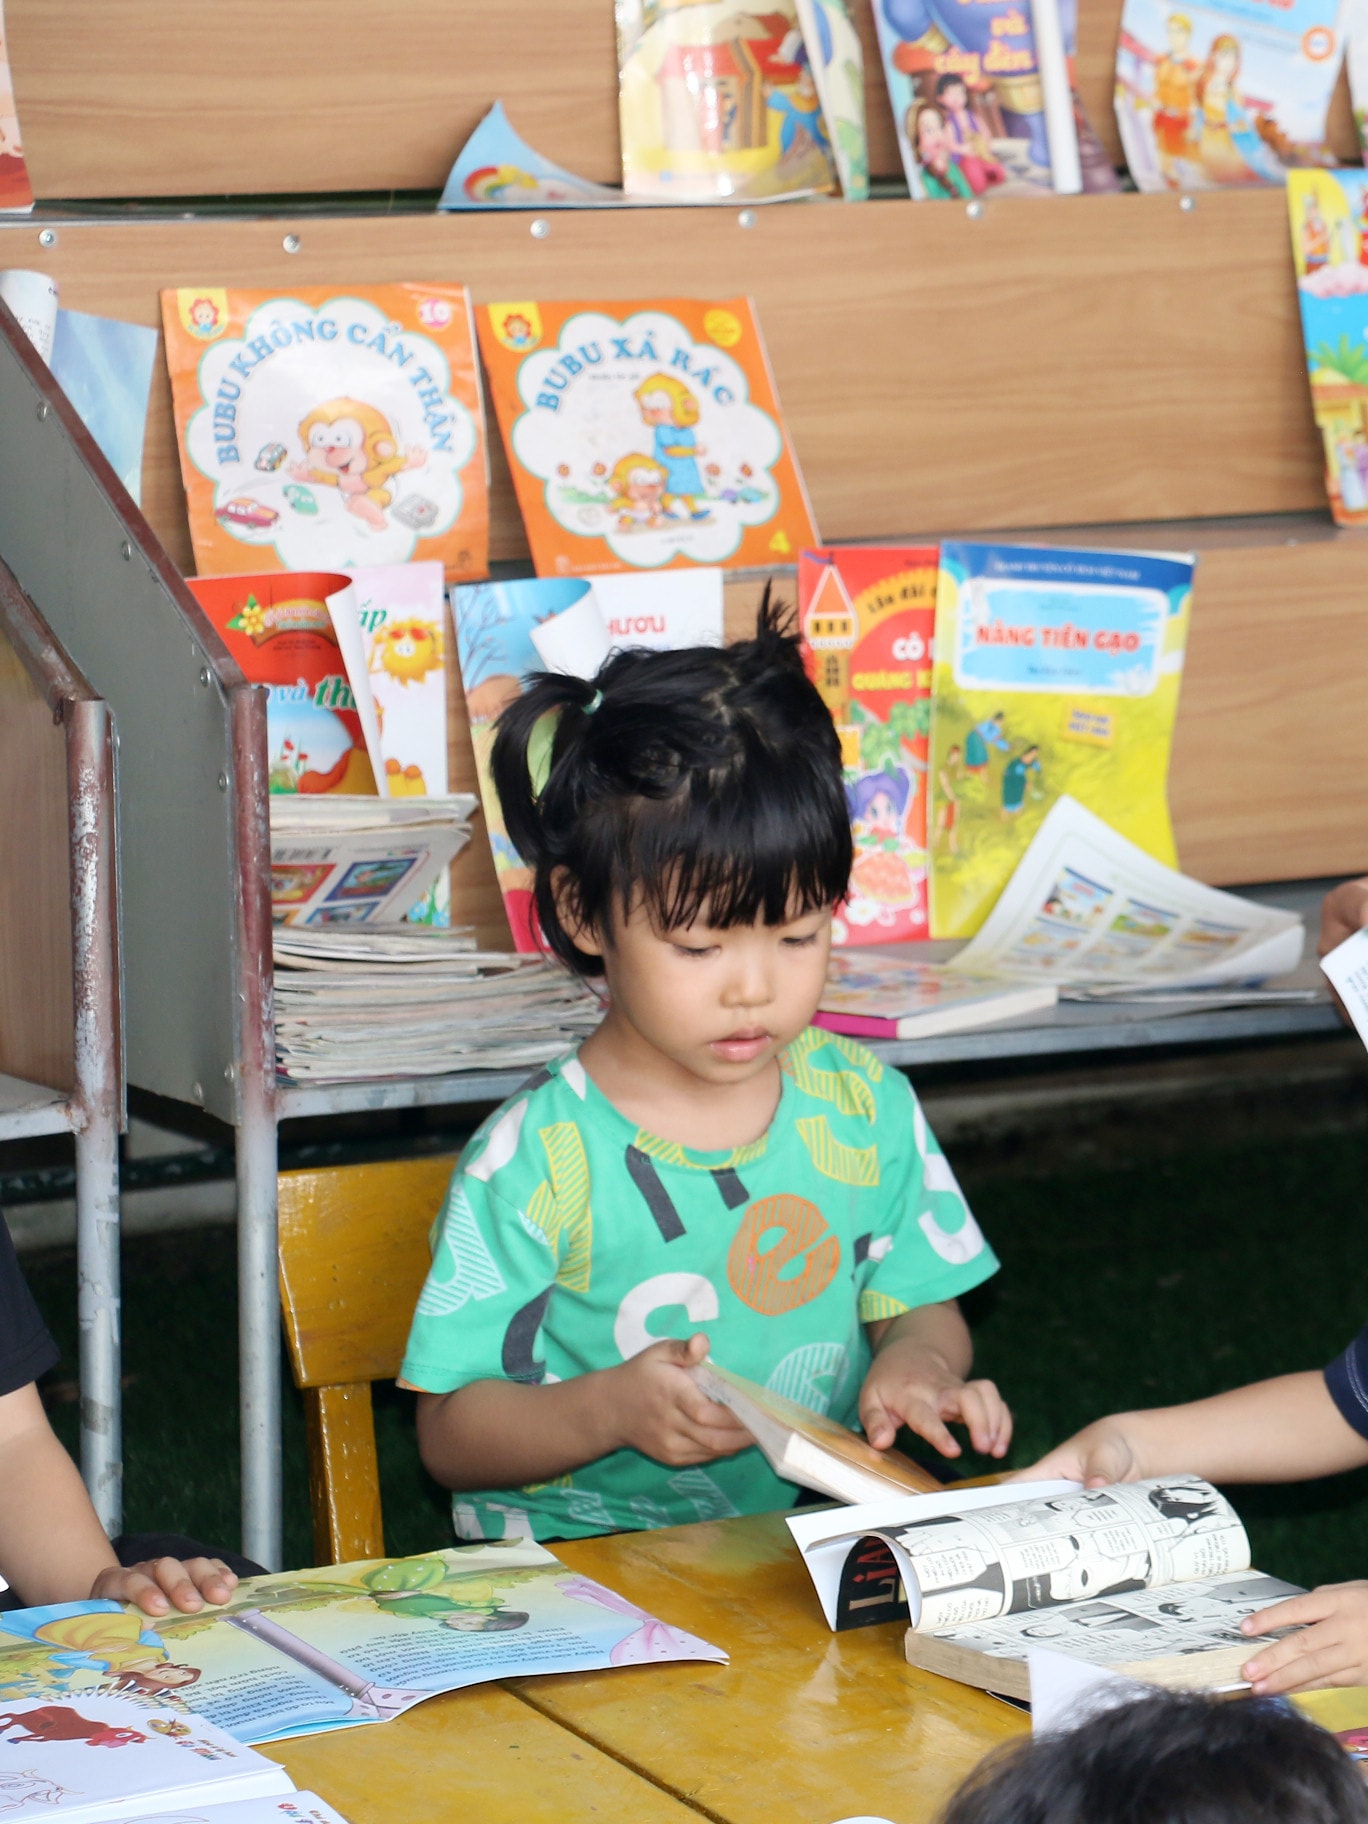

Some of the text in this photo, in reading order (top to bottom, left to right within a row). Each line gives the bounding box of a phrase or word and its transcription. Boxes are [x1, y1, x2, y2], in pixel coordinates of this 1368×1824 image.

[213, 376, 242, 465] BUBU
[229, 318, 340, 379] KHÔNG
[407, 366, 457, 453] THẬN
[535, 330, 736, 412] BUBU XẢ RÁC
[769, 529, 791, 554] 4
[976, 619, 1036, 647] NÀNG
[1094, 631, 1141, 657] GẠO
